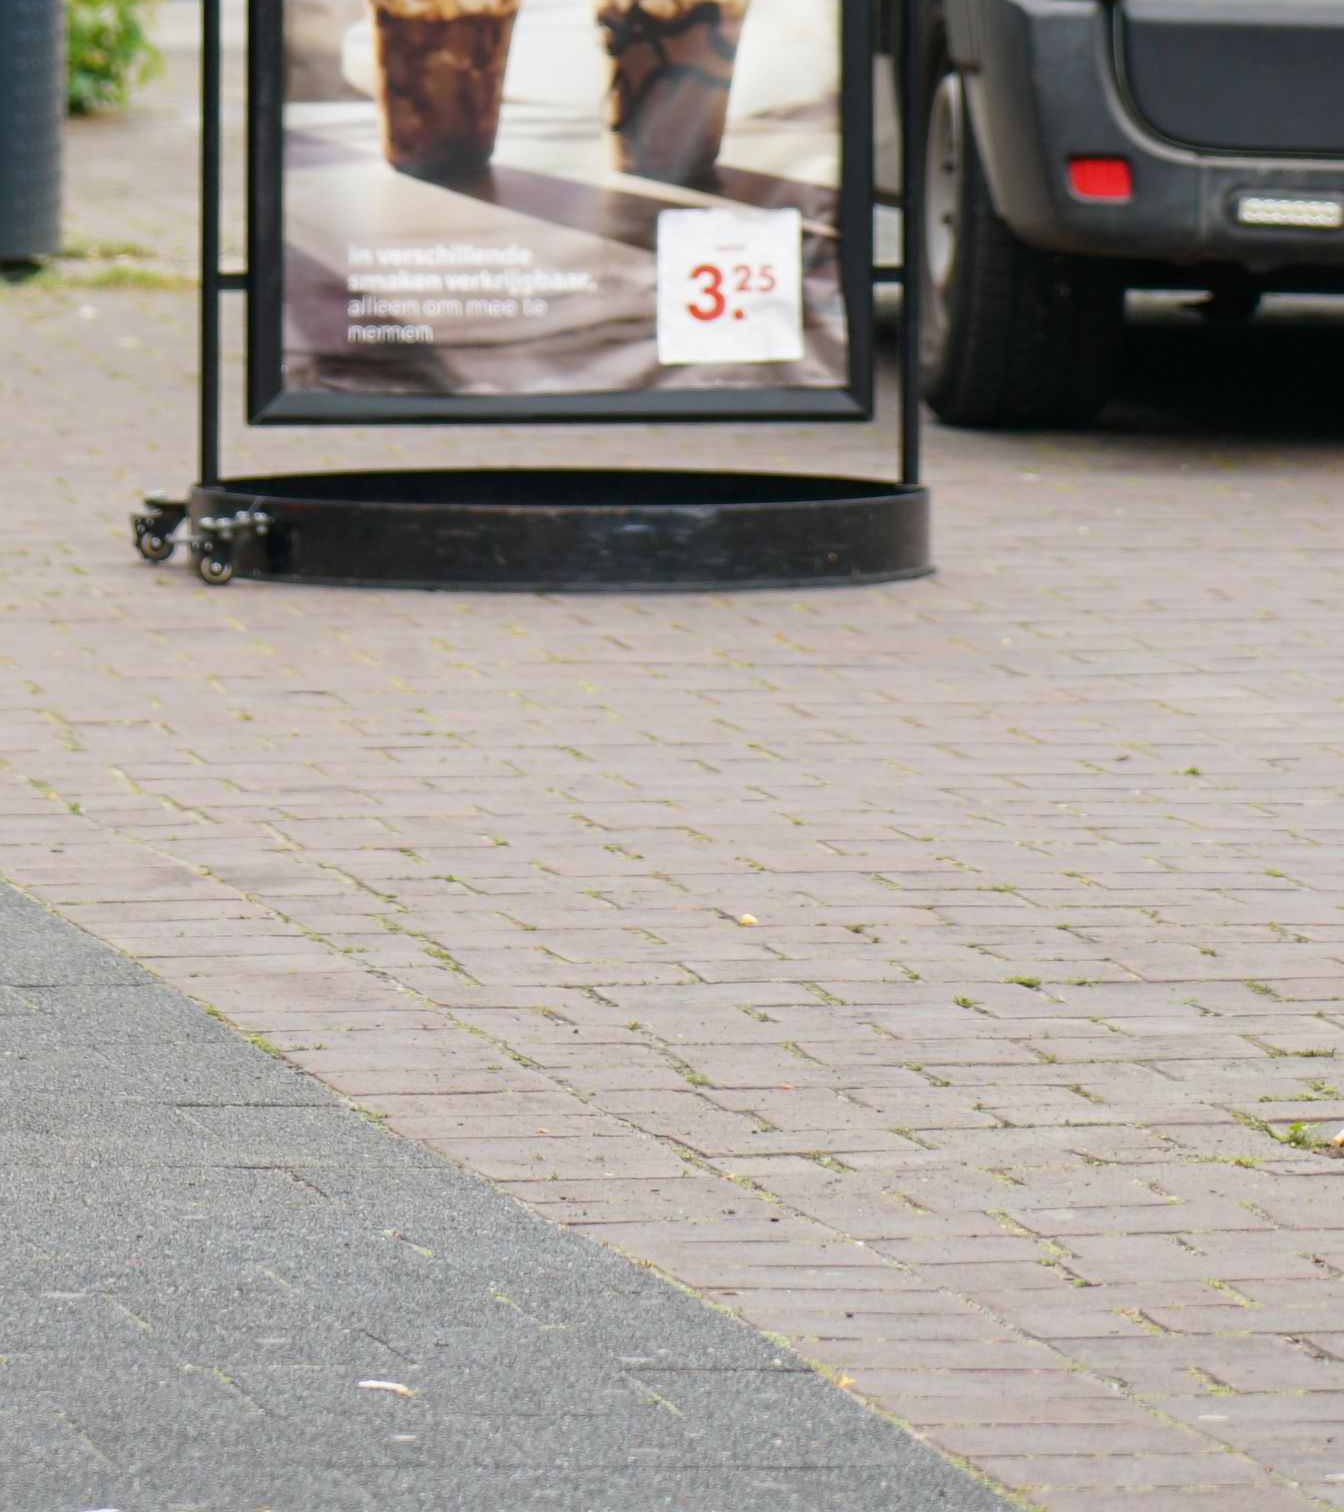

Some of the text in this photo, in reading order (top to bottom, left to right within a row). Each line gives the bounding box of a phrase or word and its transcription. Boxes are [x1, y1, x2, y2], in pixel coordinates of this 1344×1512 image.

[376, 242, 533, 266] verschillende
[347, 268, 597, 297] smaken verkrijgbaar.
[347, 296, 548, 317] alleen om mee te
[347, 324, 434, 344] nemen
